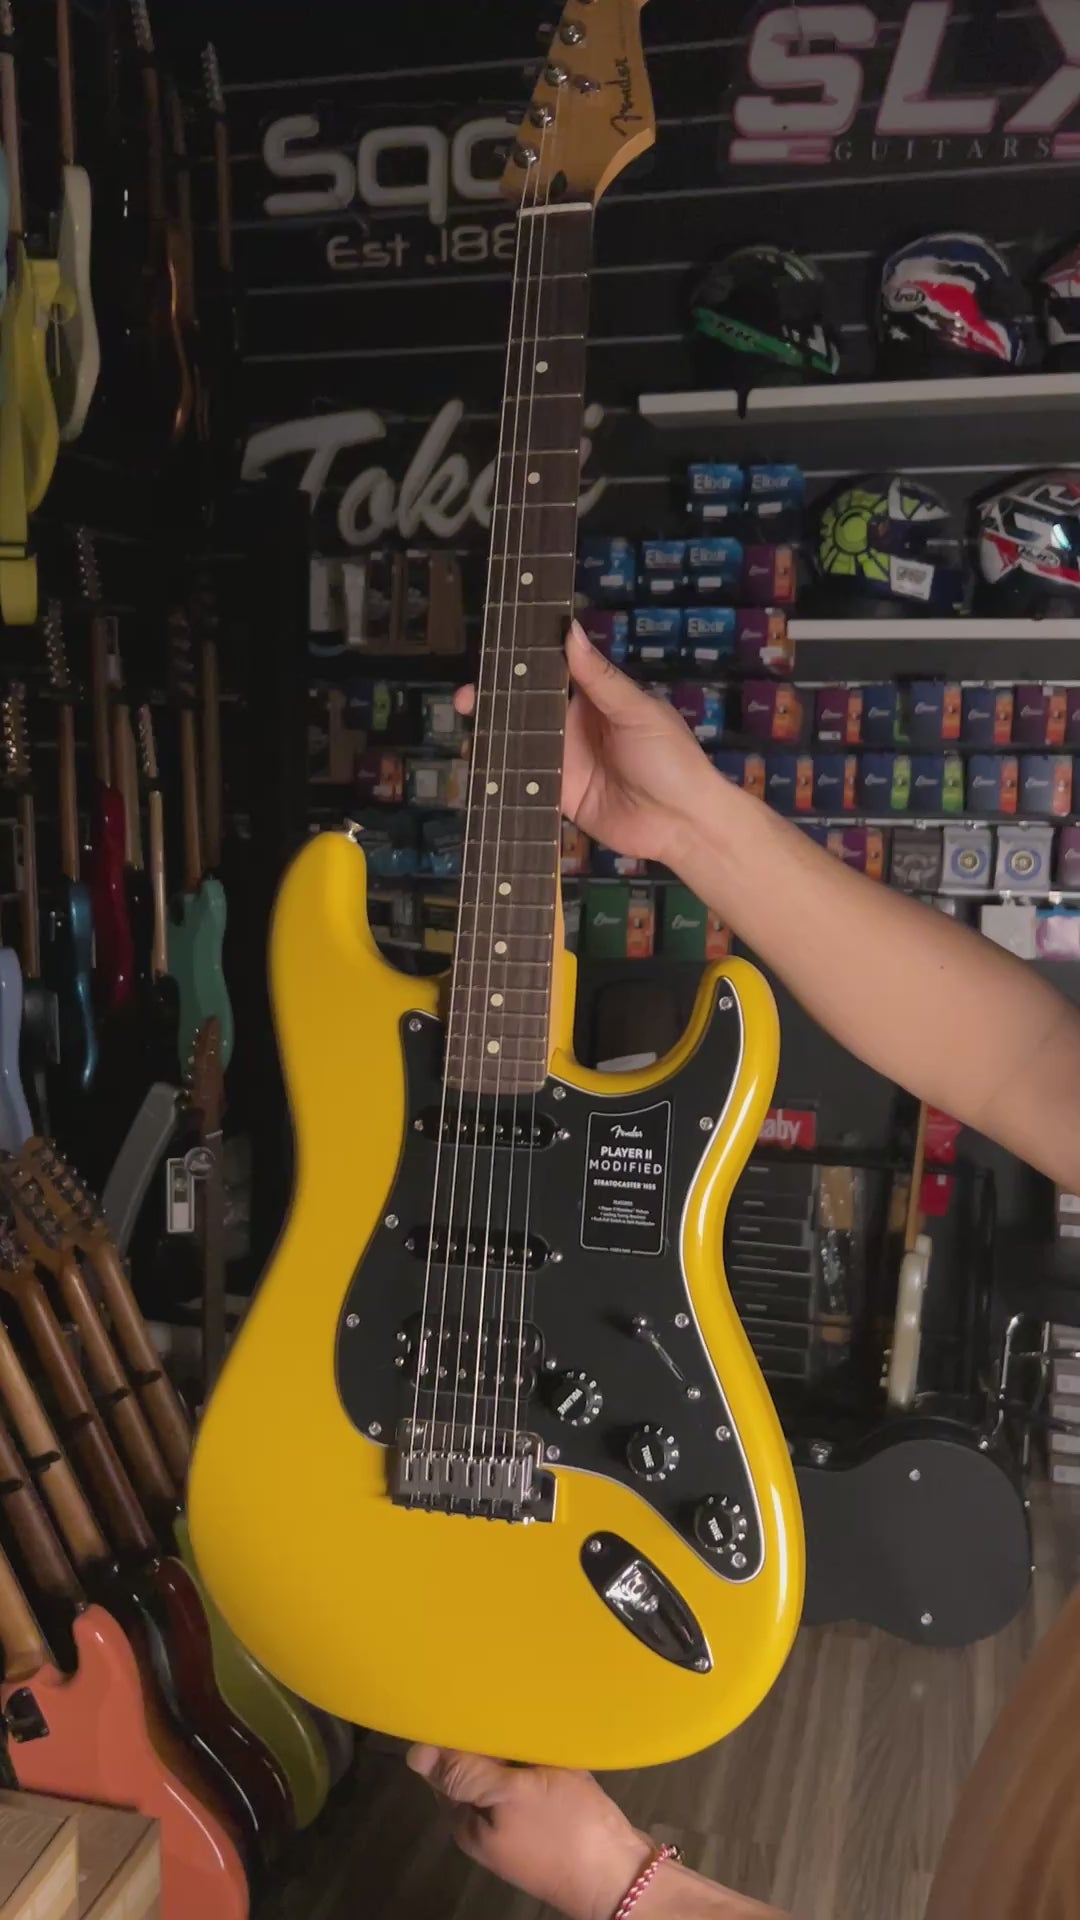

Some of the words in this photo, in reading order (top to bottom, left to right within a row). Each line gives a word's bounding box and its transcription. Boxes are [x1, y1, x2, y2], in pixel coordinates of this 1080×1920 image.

[834, 138, 1050, 162] GUITARS
[326, 234, 410, 269] Est
[240, 399, 606, 547] Toki
[693, 473, 732, 491] Elixir
[610, 1124, 644, 1139] Fender
[600, 1145, 643, 1159] PLAYER
[645, 1148, 653, 1160] II
[589, 1159, 663, 1175] MODIFIED
[557, 1388, 583, 1416] VOLUME
[641, 1444, 655, 1469] TONE
[708, 1516, 724, 1542] TONE
